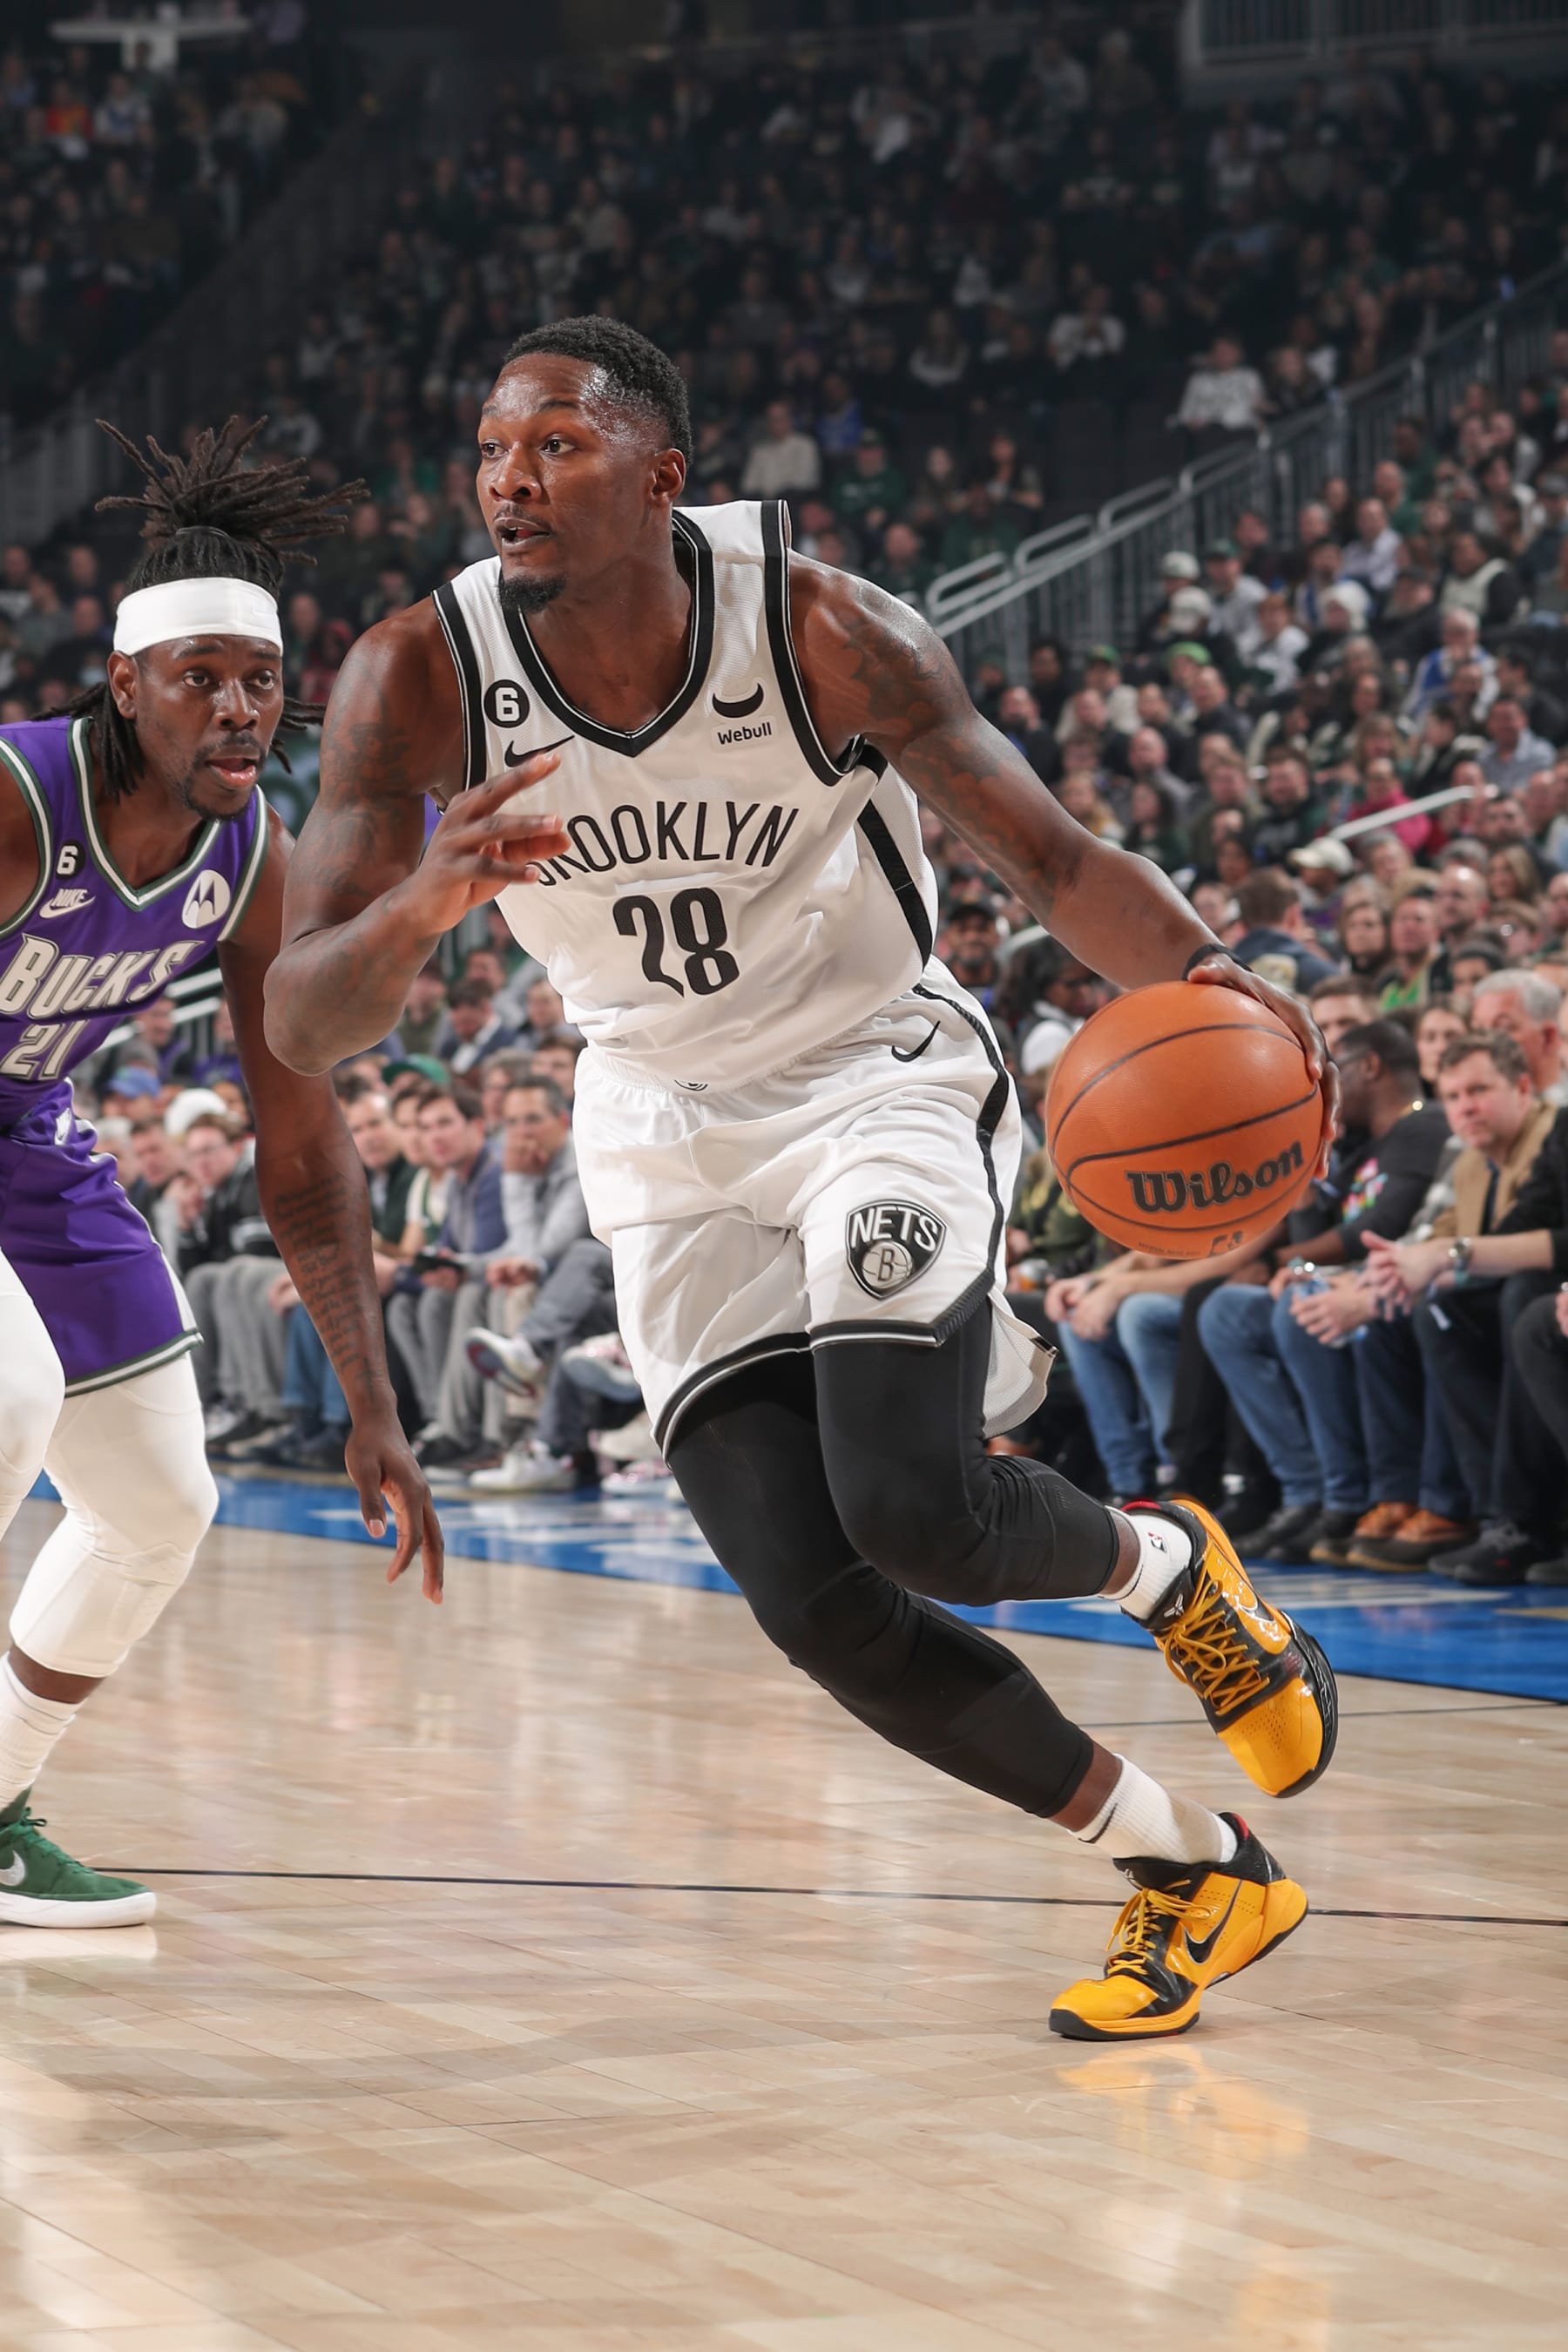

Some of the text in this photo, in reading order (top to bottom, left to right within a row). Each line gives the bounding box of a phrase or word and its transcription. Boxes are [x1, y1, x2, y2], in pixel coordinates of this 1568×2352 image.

[494, 686, 520, 722] 6
[717, 721, 773, 746] Webull
[56, 844, 80, 876] 6
[51, 888, 88, 907] NIKE
[612, 887, 740, 998] 28
[0, 933, 205, 1019] BUCKS
[0, 1019, 90, 1081] 21
[1125, 1140, 1304, 1213] Wilson
[850, 1205, 940, 1253] NETS
[877, 1248, 896, 1281] B
